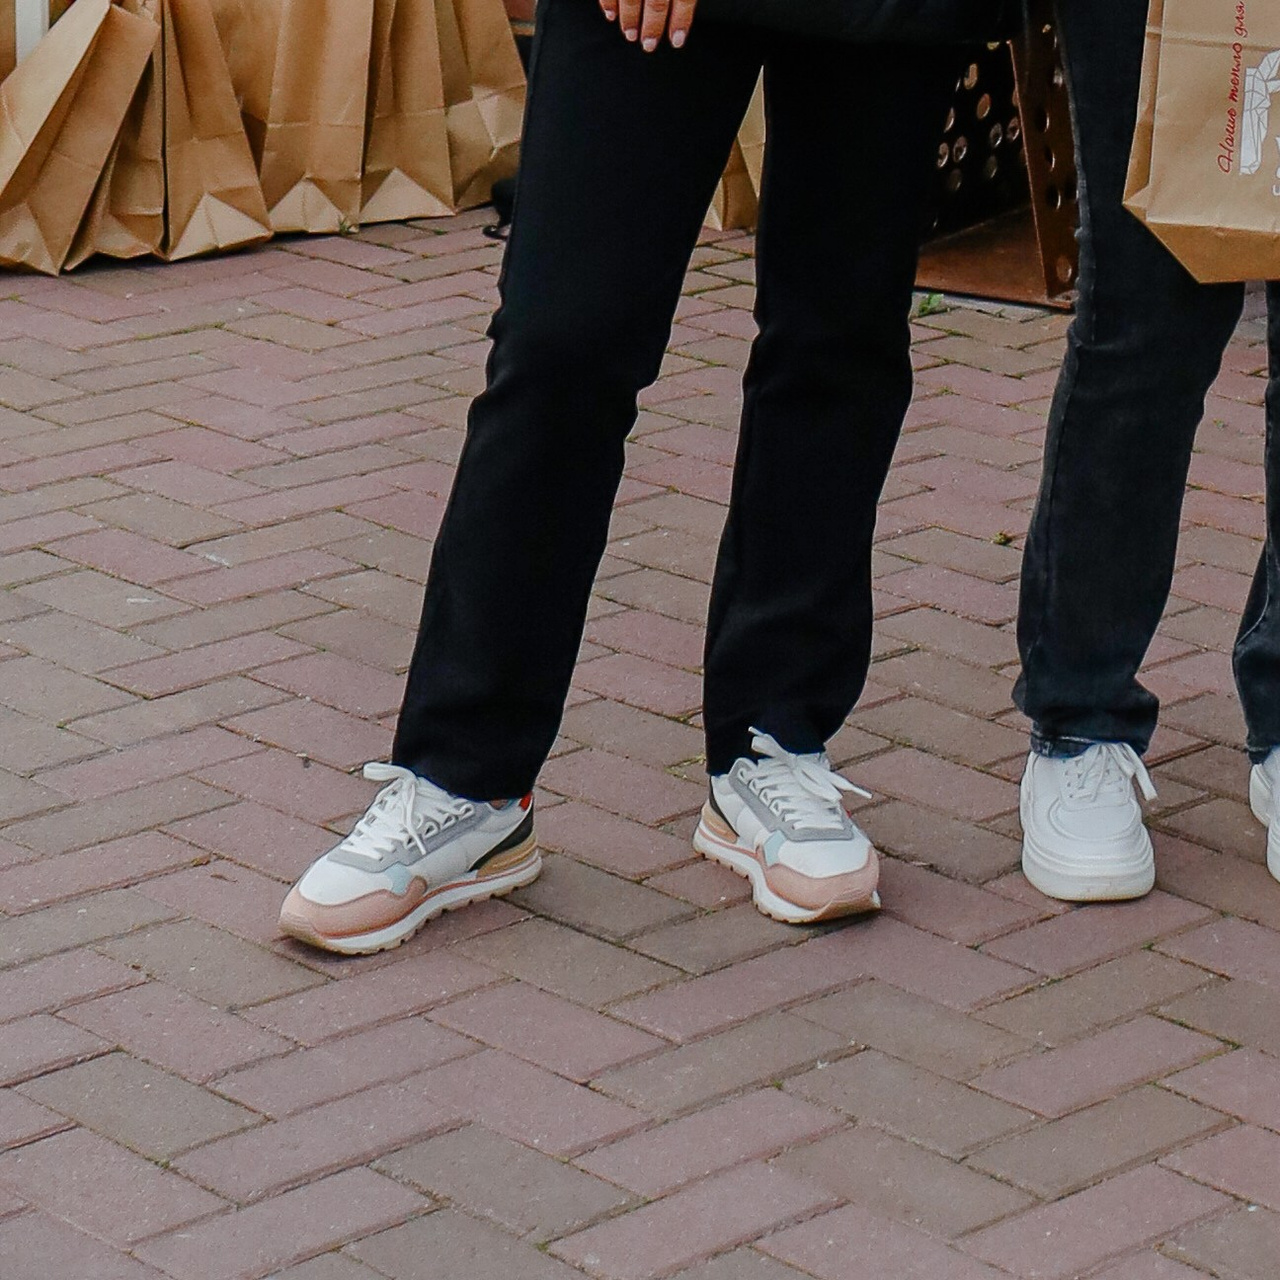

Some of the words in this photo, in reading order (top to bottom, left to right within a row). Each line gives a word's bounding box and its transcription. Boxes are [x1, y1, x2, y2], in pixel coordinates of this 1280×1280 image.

[1218, 108, 1237, 174] Наше
[1228, 42, 1242, 103] тепло
[1235, 0, 1248, 38] для
